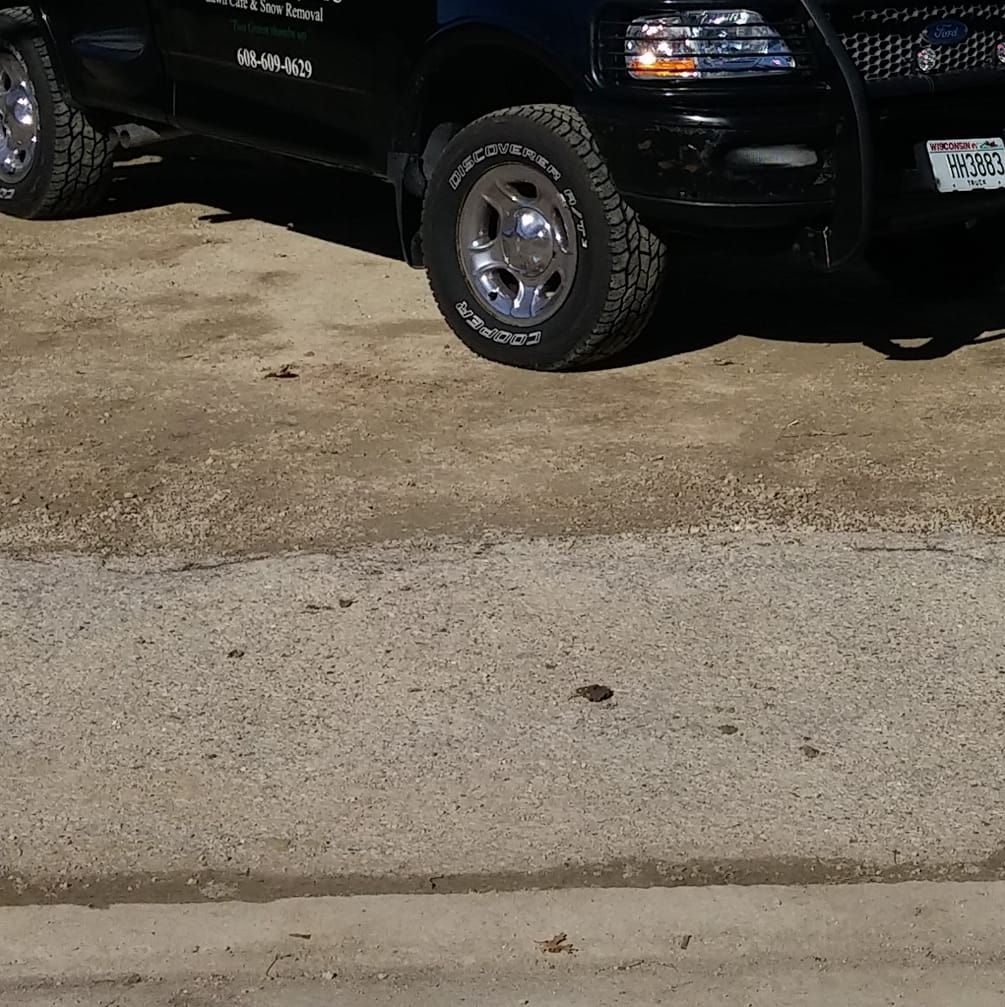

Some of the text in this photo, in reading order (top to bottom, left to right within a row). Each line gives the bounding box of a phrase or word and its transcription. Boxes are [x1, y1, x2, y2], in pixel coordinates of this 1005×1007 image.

[286, 2, 324, 23] Removal
[934, 24, 959, 39] Ford
[236, 47, 313, 79] 608-609-0629
[930, 142, 972, 152] WISCONSIN
[449, 143, 561, 190] DISCOVERER
[946, 152, 1005, 179] HH3883
[456, 300, 541, 346] COOPER
